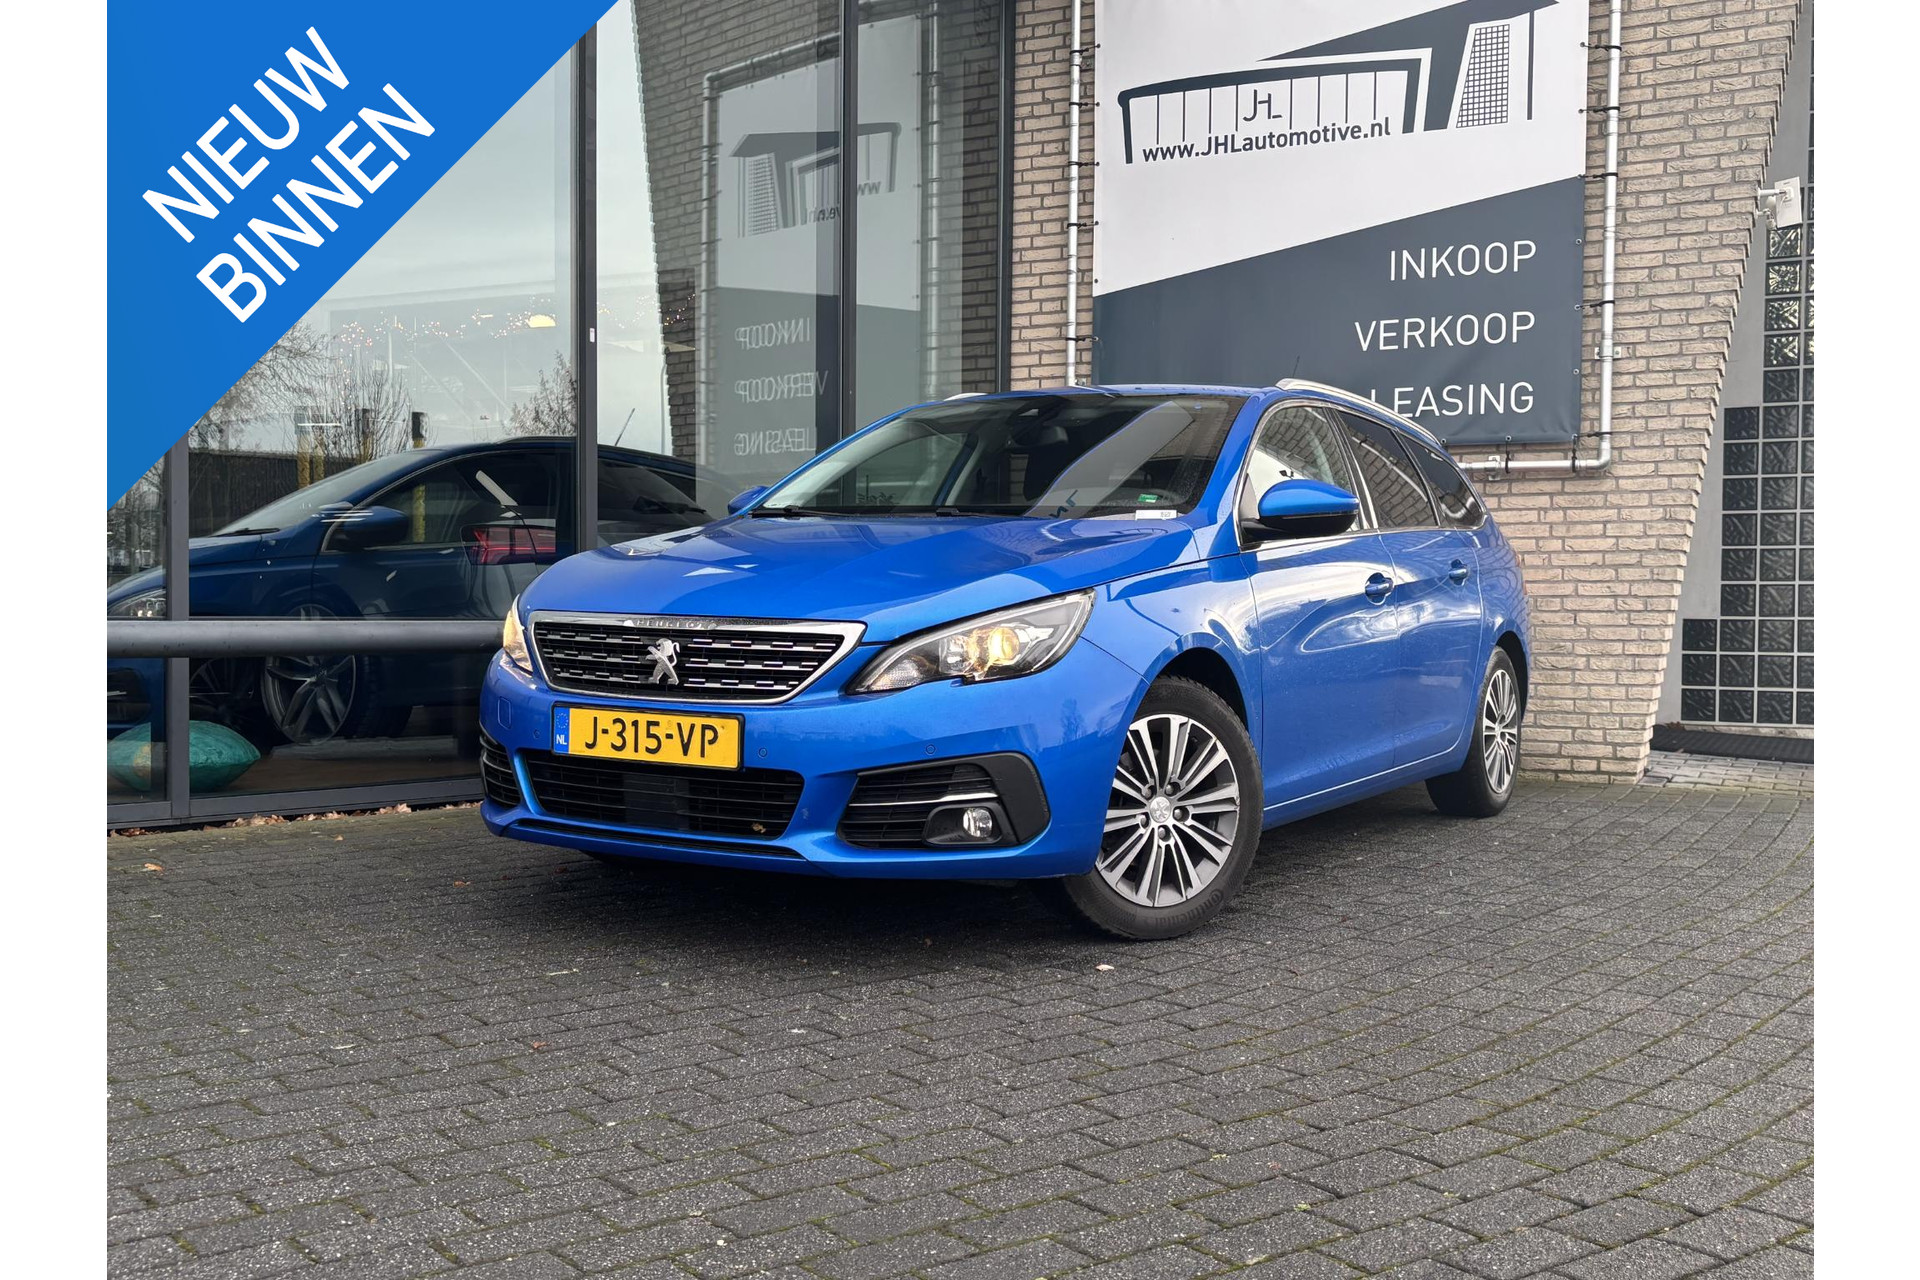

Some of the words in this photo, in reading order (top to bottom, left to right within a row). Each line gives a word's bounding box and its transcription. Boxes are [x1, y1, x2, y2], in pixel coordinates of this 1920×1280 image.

[1143, 116, 1391, 163] www.JHLautomotive.nl
[1389, 240, 1537, 281] INKOOP
[1355, 311, 1535, 352] VERKOOP
[556, 734, 568, 746] NL
[585, 716, 719, 758] J-315-VP
